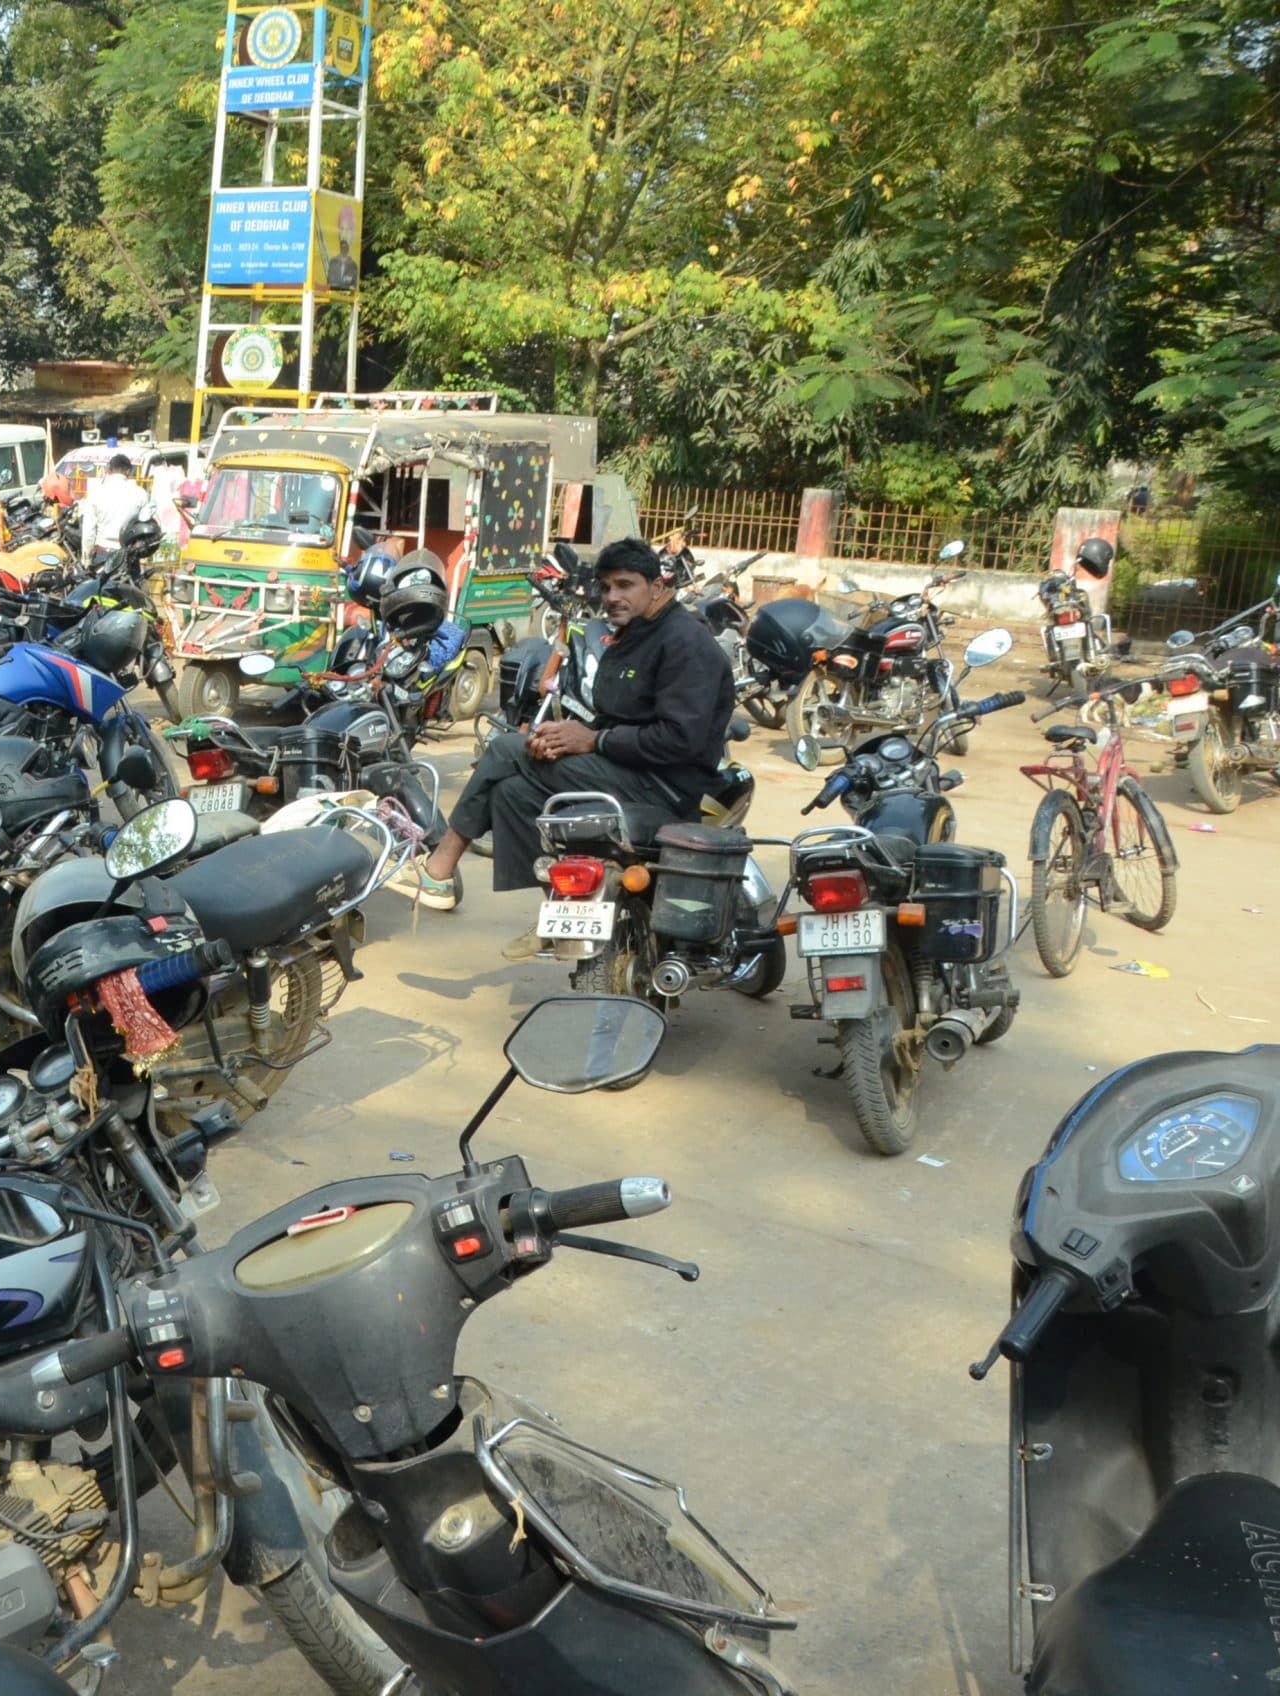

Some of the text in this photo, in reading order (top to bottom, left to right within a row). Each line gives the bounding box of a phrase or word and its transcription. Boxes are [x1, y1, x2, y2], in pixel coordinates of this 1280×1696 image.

[228, 73, 310, 89] INNER WHEEL CLUB
[241, 90, 294, 105] OF DEOGHAR
[216, 199, 308, 214] INNER WHEEL CLUB
[230, 218, 290, 232] OF DEOGHAR
[546, 919, 602, 934] 7875
[822, 914, 871, 930] JH15A
[821, 931, 871, 947] C9130
